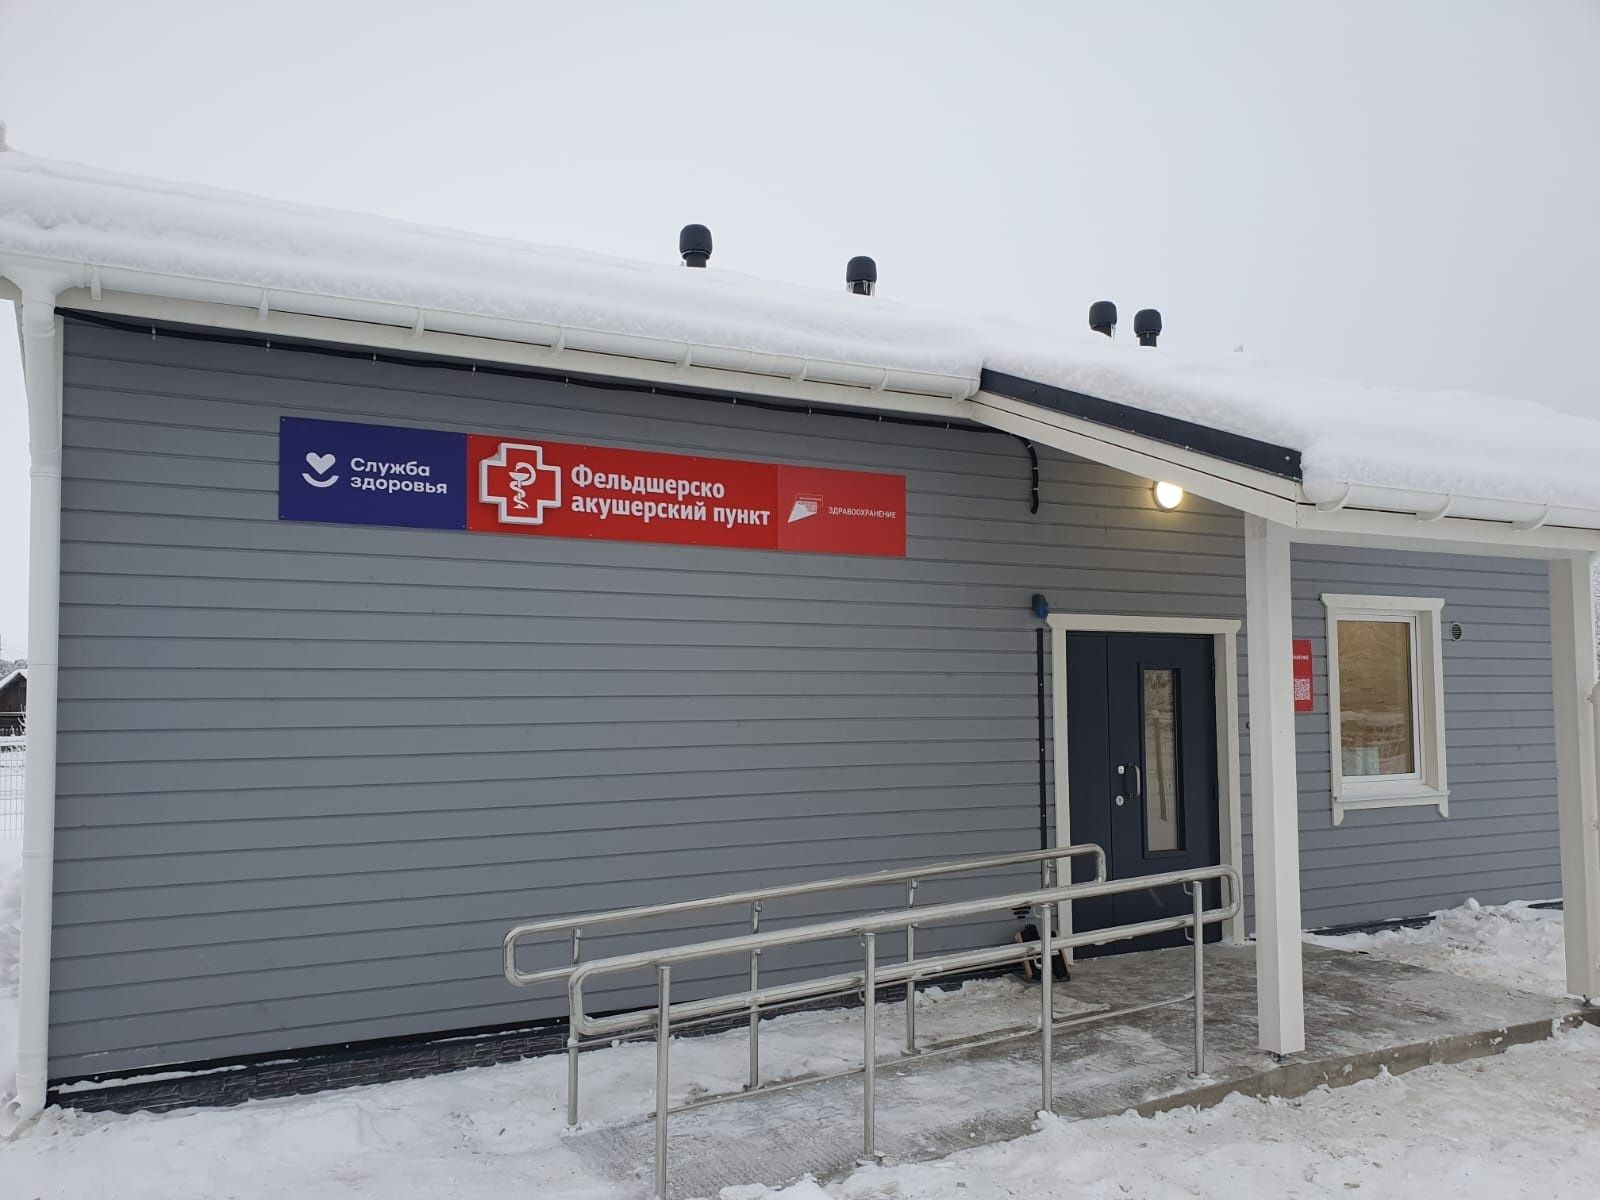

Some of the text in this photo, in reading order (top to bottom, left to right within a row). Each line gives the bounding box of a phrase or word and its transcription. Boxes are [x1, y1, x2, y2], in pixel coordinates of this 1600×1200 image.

[350, 457, 430, 477] Служба
[350, 476, 448, 494] здоровья
[571, 464, 725, 499] Фельдшерско
[571, 495, 771, 528] акушерский пункт
[828, 506, 897, 519] ЗДРАВООХРАНЕНИЕ
